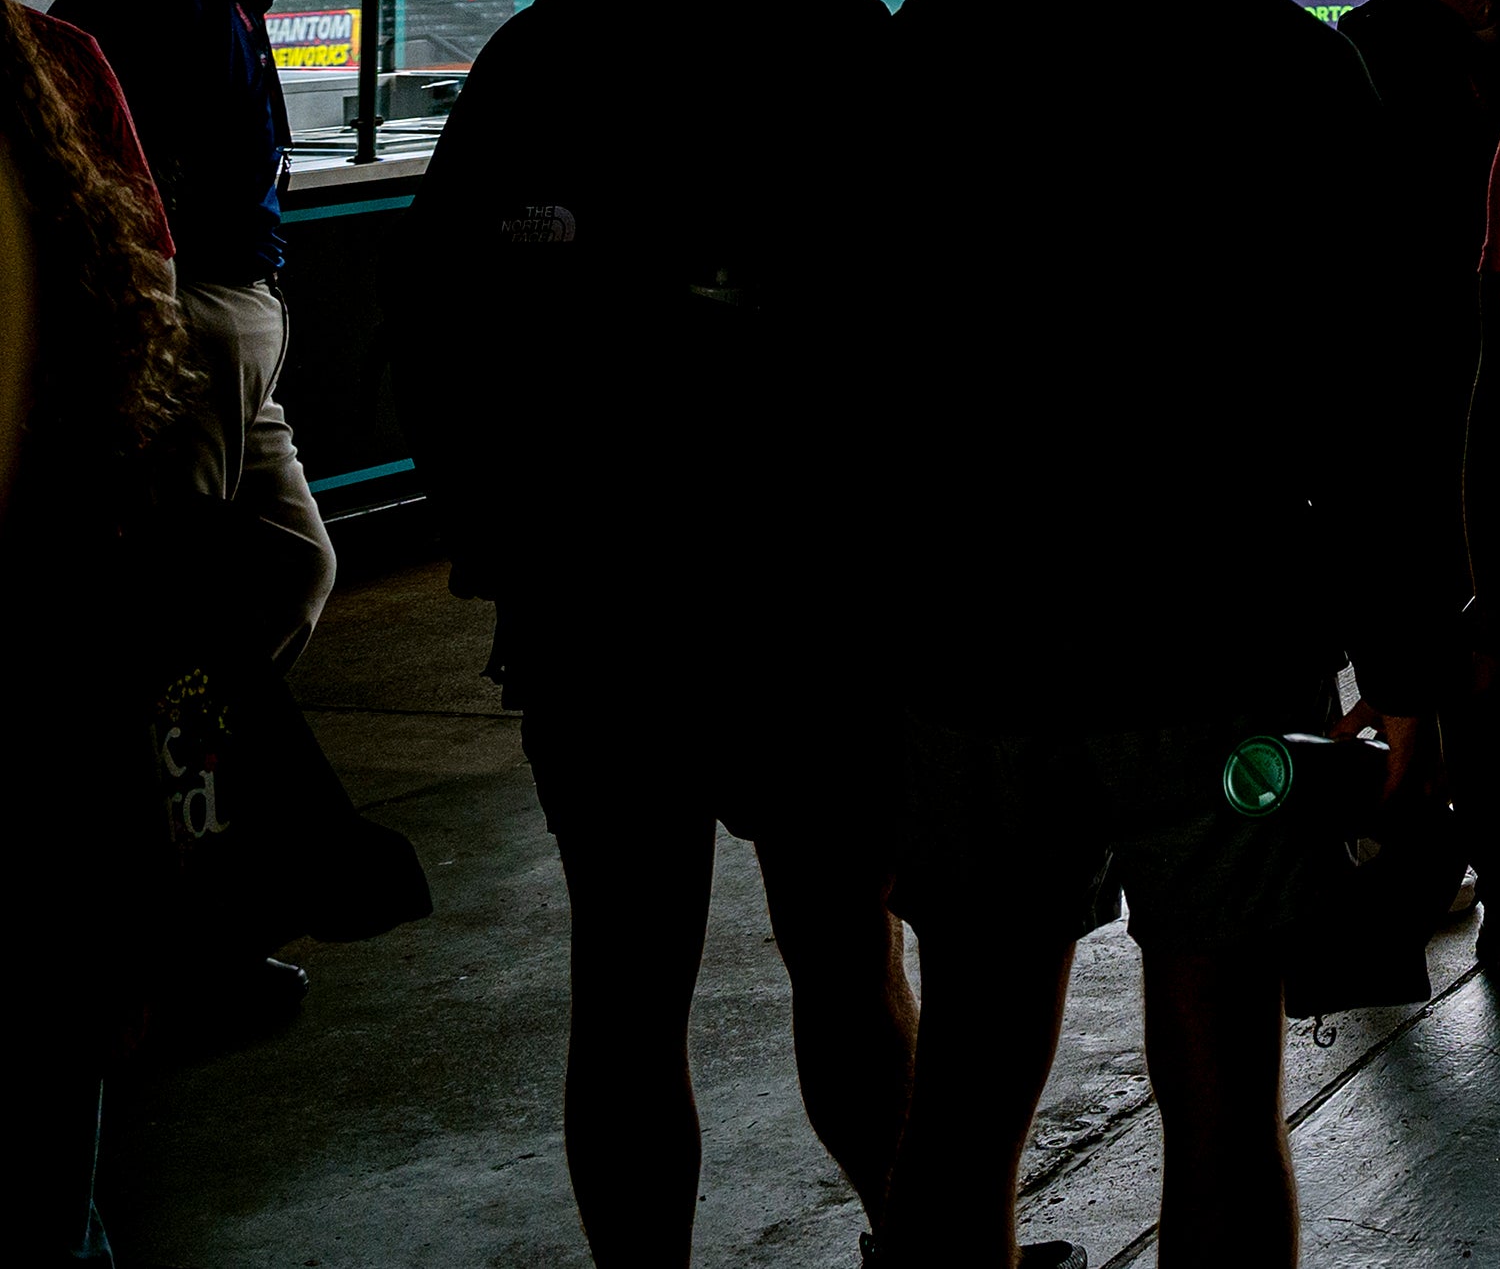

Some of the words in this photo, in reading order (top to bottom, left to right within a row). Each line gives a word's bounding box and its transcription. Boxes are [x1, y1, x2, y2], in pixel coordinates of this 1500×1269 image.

[266, 15, 351, 44] HANTOM
[273, 43, 350, 67] EWORKS
[525, 205, 553, 218] THE
[501, 219, 551, 232] NORTH
